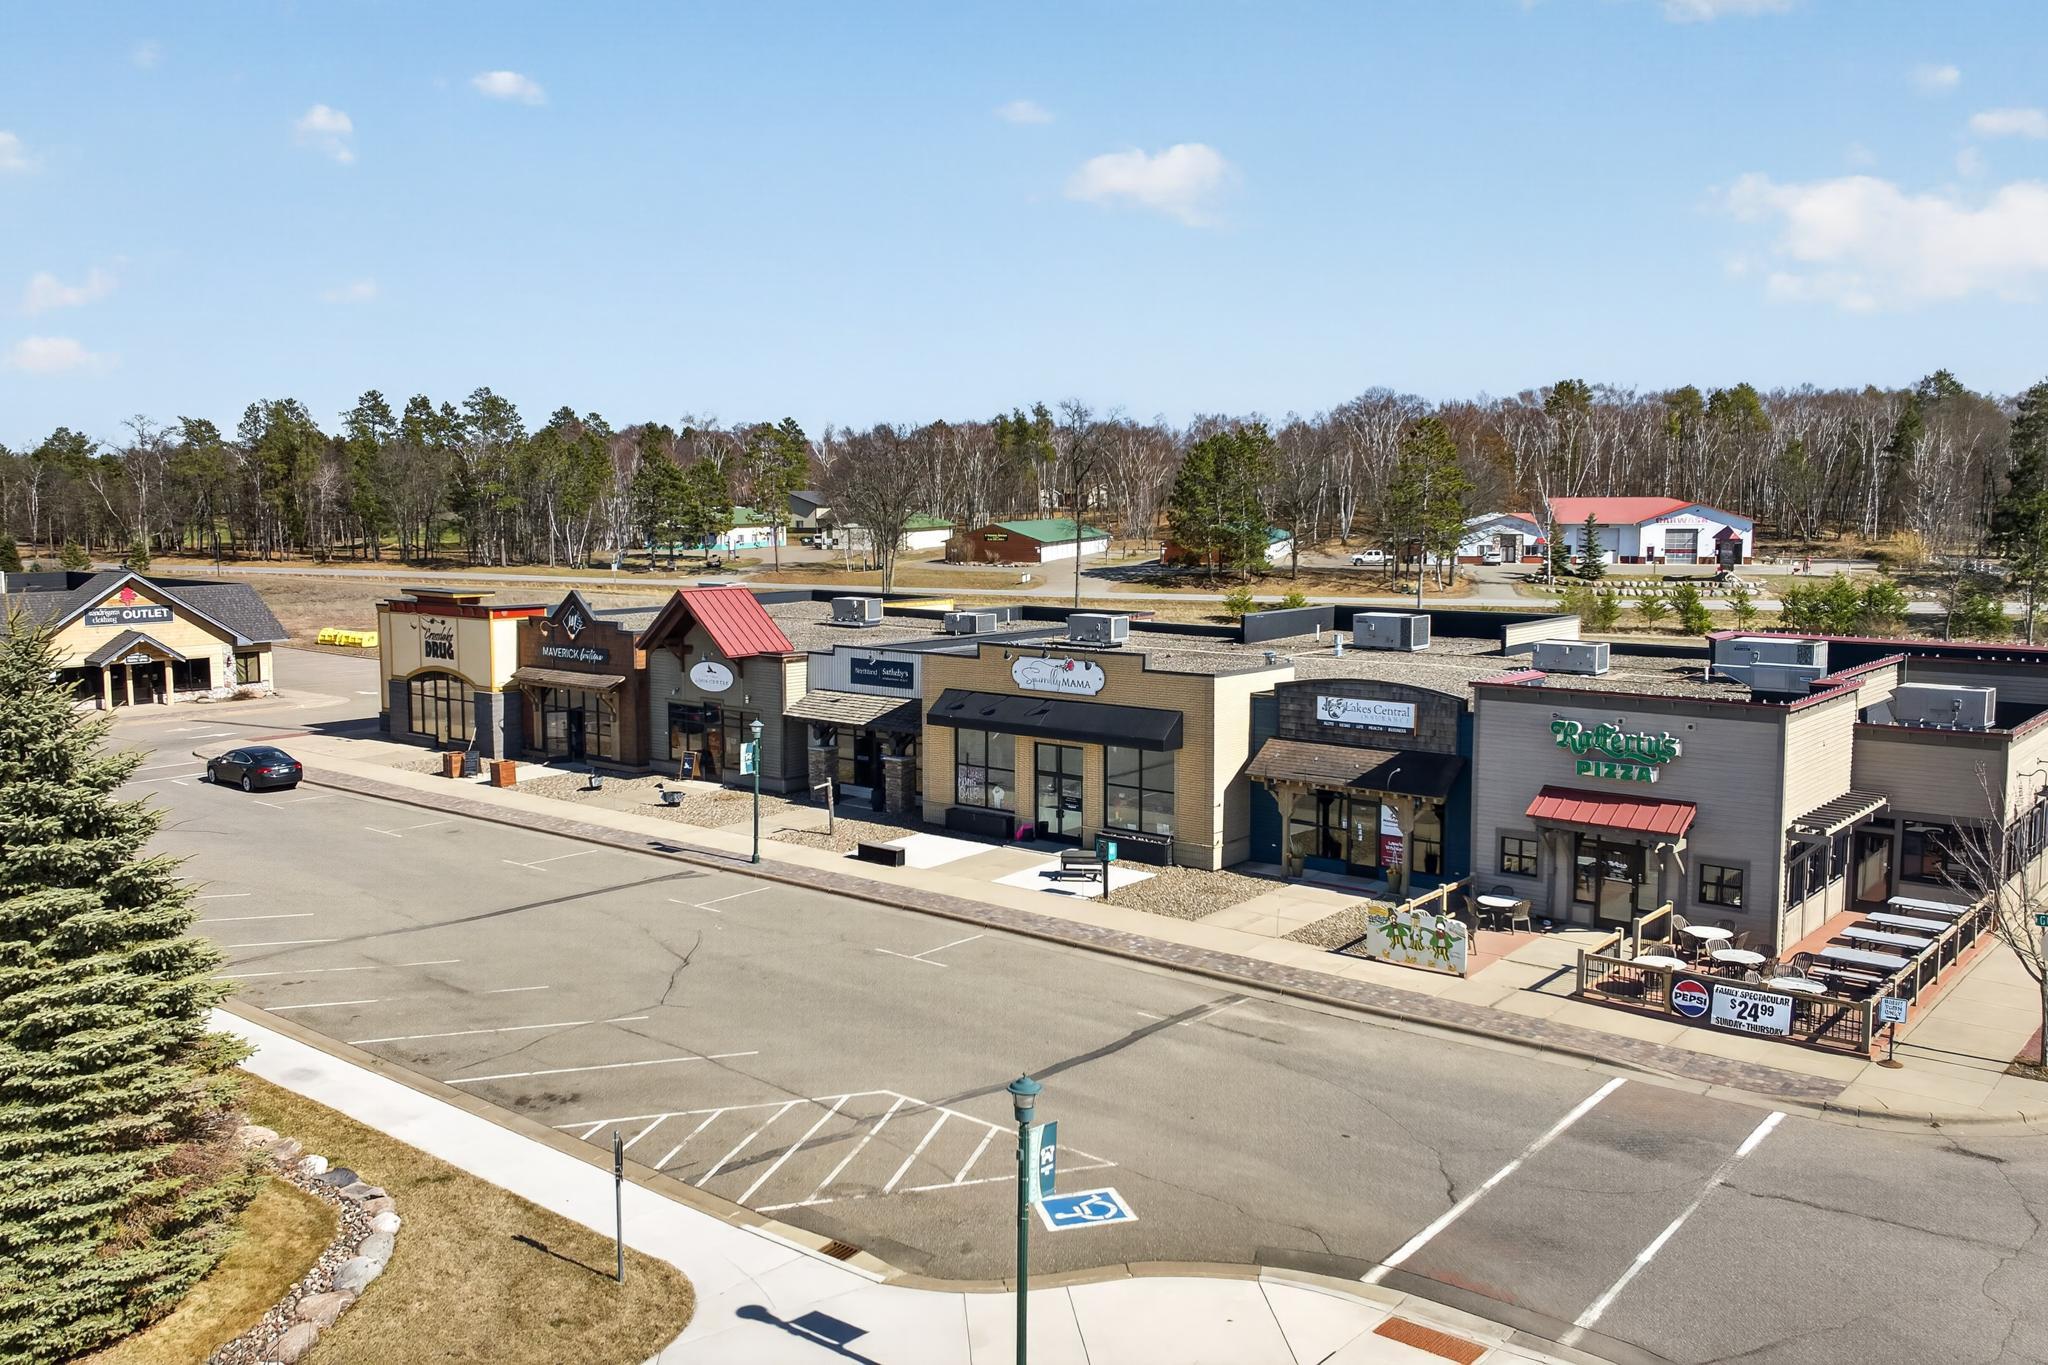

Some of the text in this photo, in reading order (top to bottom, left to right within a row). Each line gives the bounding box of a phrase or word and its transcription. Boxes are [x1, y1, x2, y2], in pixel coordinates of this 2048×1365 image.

[122, 607, 169, 620] OUTLET
[425, 640, 454, 660] DRUG
[542, 646, 579, 660] MAVERICK
[1343, 701, 1410, 718] Lakes Central
[1550, 719, 1682, 765] Rafferty's
[1575, 760, 1660, 783] PIZZA
[1674, 991, 1707, 1006] PEPSI
[1714, 986, 1790, 1007] FAMILY SPECTACULAR
